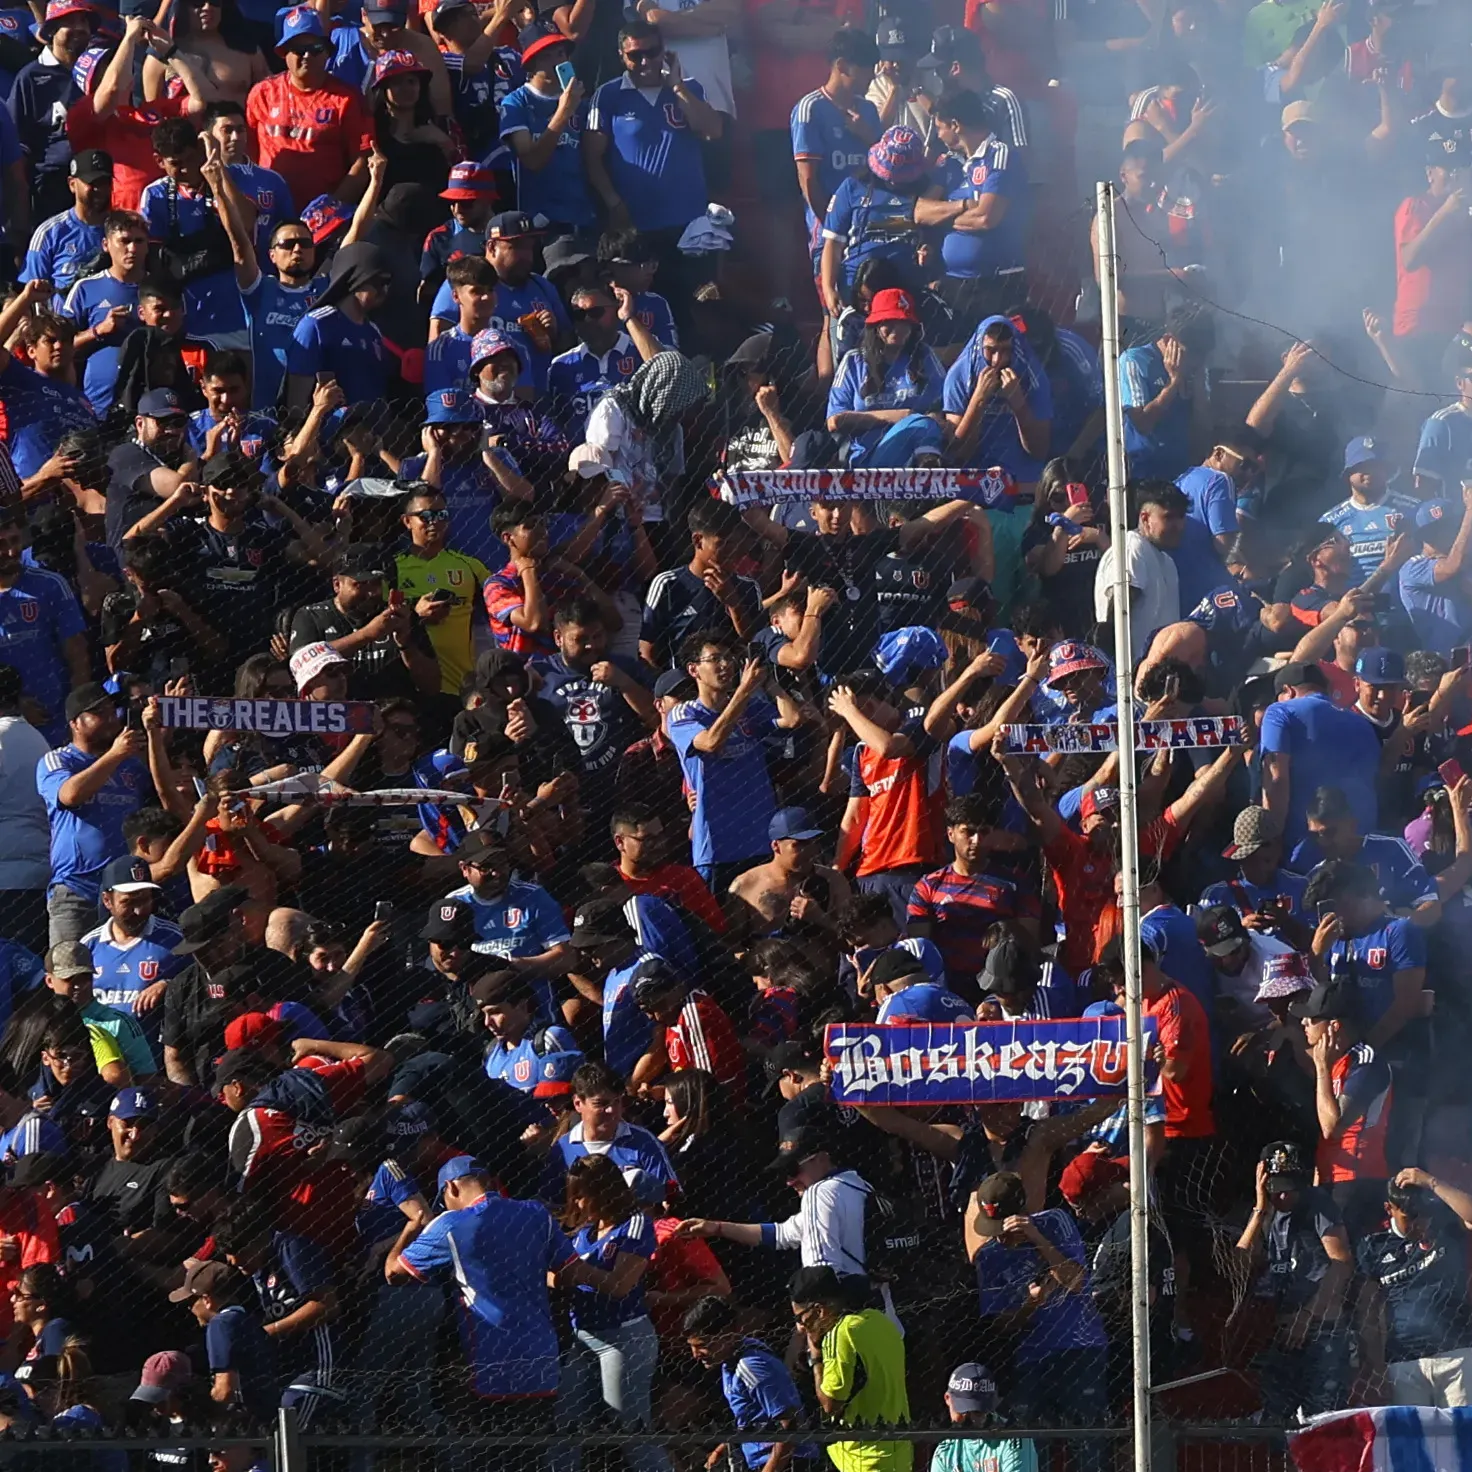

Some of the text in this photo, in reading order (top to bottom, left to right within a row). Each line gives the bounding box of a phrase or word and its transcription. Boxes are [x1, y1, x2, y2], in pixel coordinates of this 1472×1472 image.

[850, 468, 962, 494] SIEMPRE
[160, 701, 347, 732] THE REALES
[138, 961, 158, 981] U
